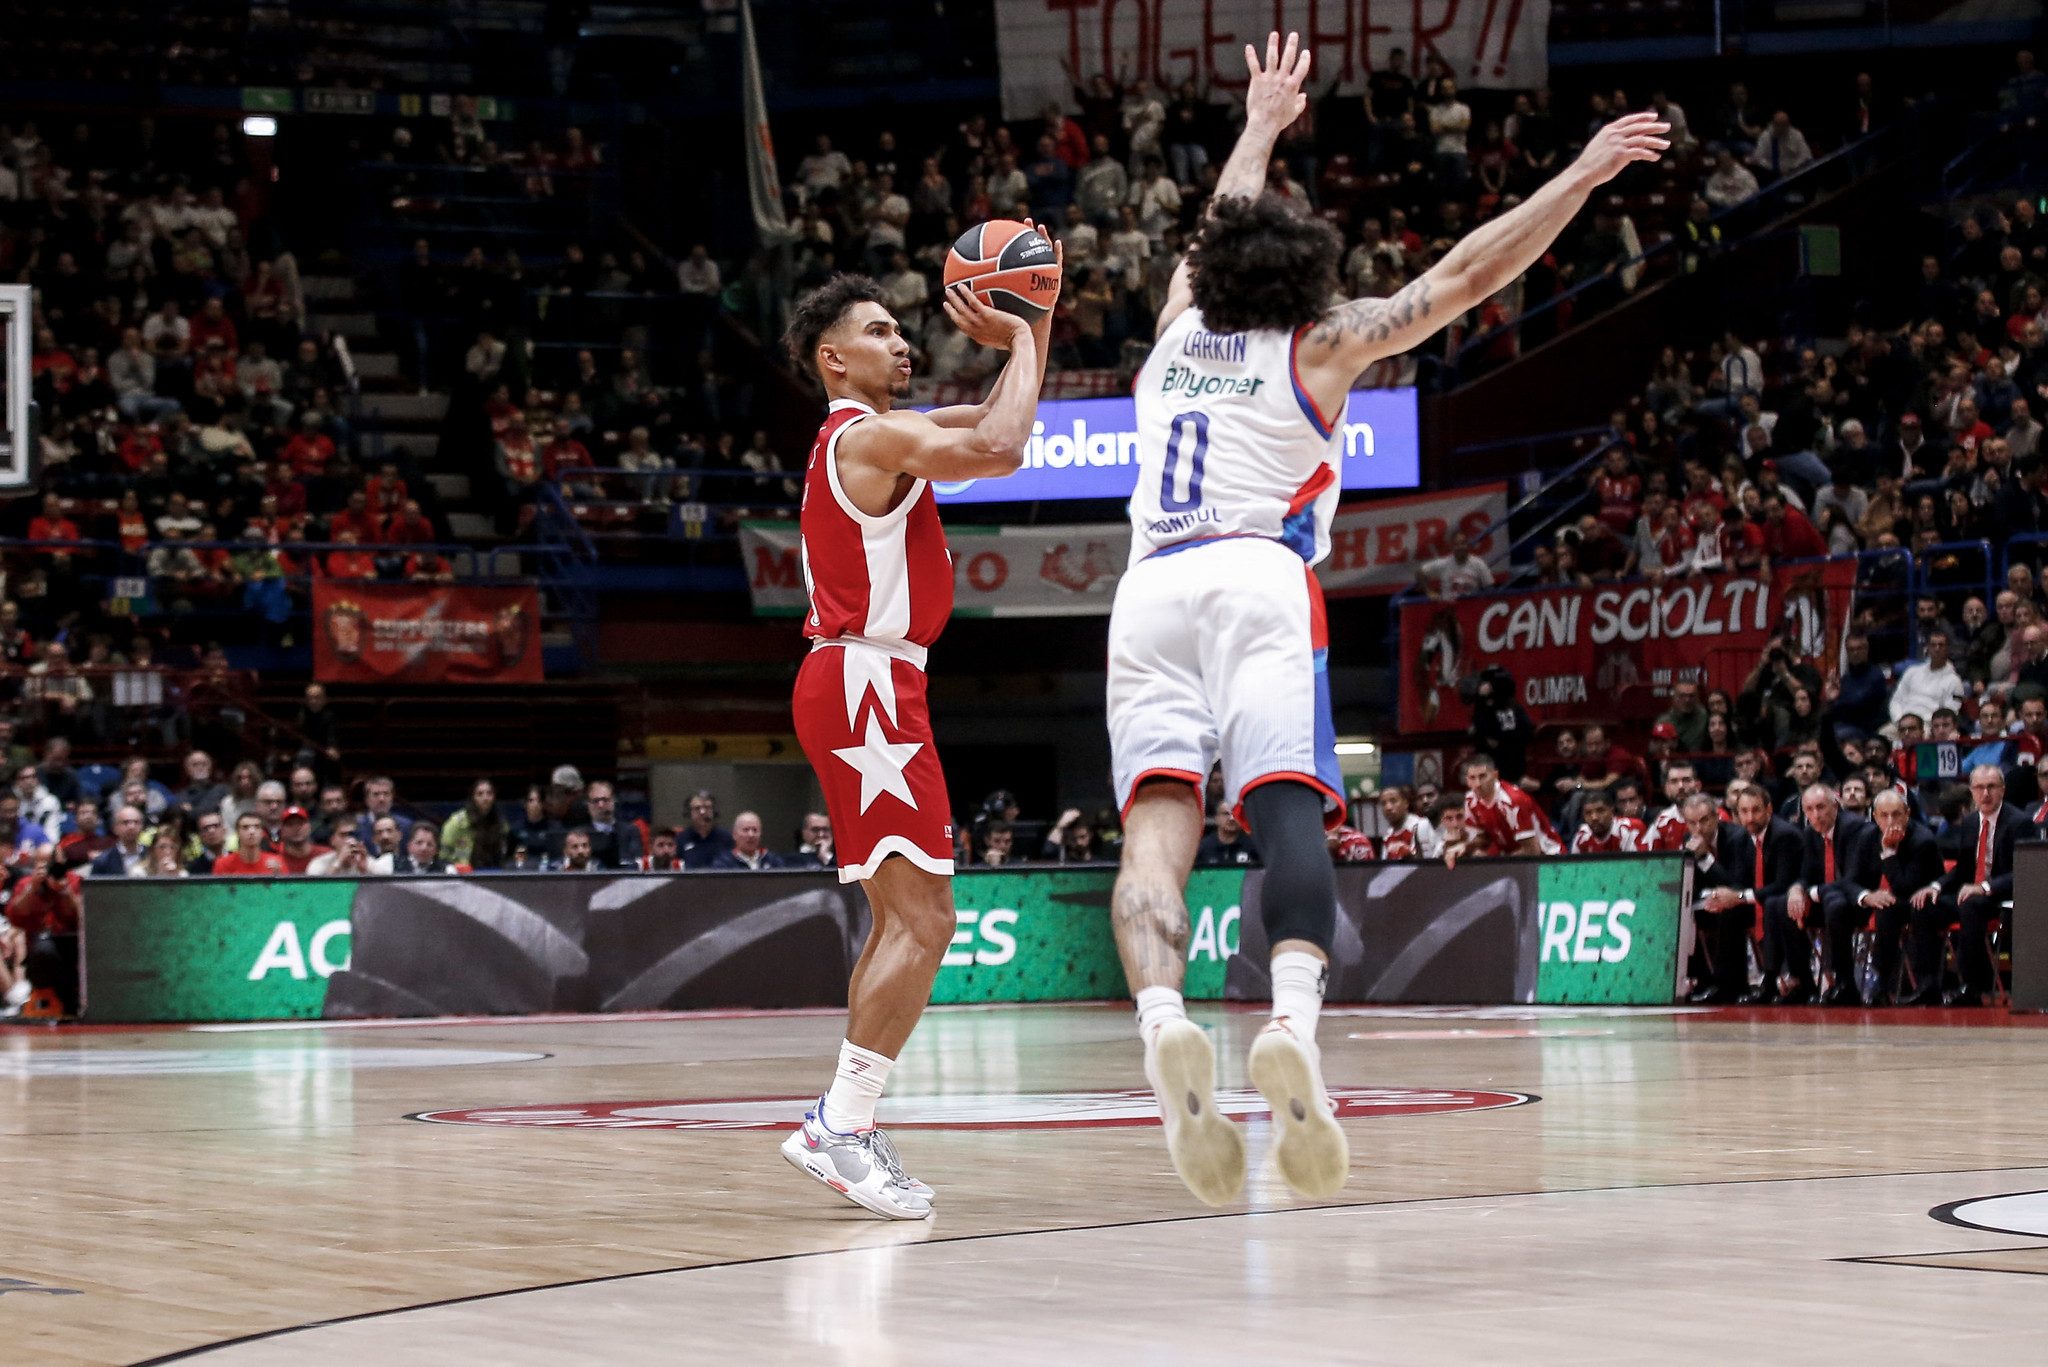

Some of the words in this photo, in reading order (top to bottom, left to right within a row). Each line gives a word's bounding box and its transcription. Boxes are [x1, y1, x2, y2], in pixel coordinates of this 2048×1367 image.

[1183, 331, 1246, 362] LARKIN
[1161, 361, 1264, 398] Bilyoner
[1019, 418, 1142, 469] iolan
[1160, 411, 1209, 513] 0
[1478, 592, 1582, 653] CANI
[1590, 578, 1770, 645] SCIOLTI
[1940, 750, 1959, 772] 19
[1538, 899, 1636, 963] RES
